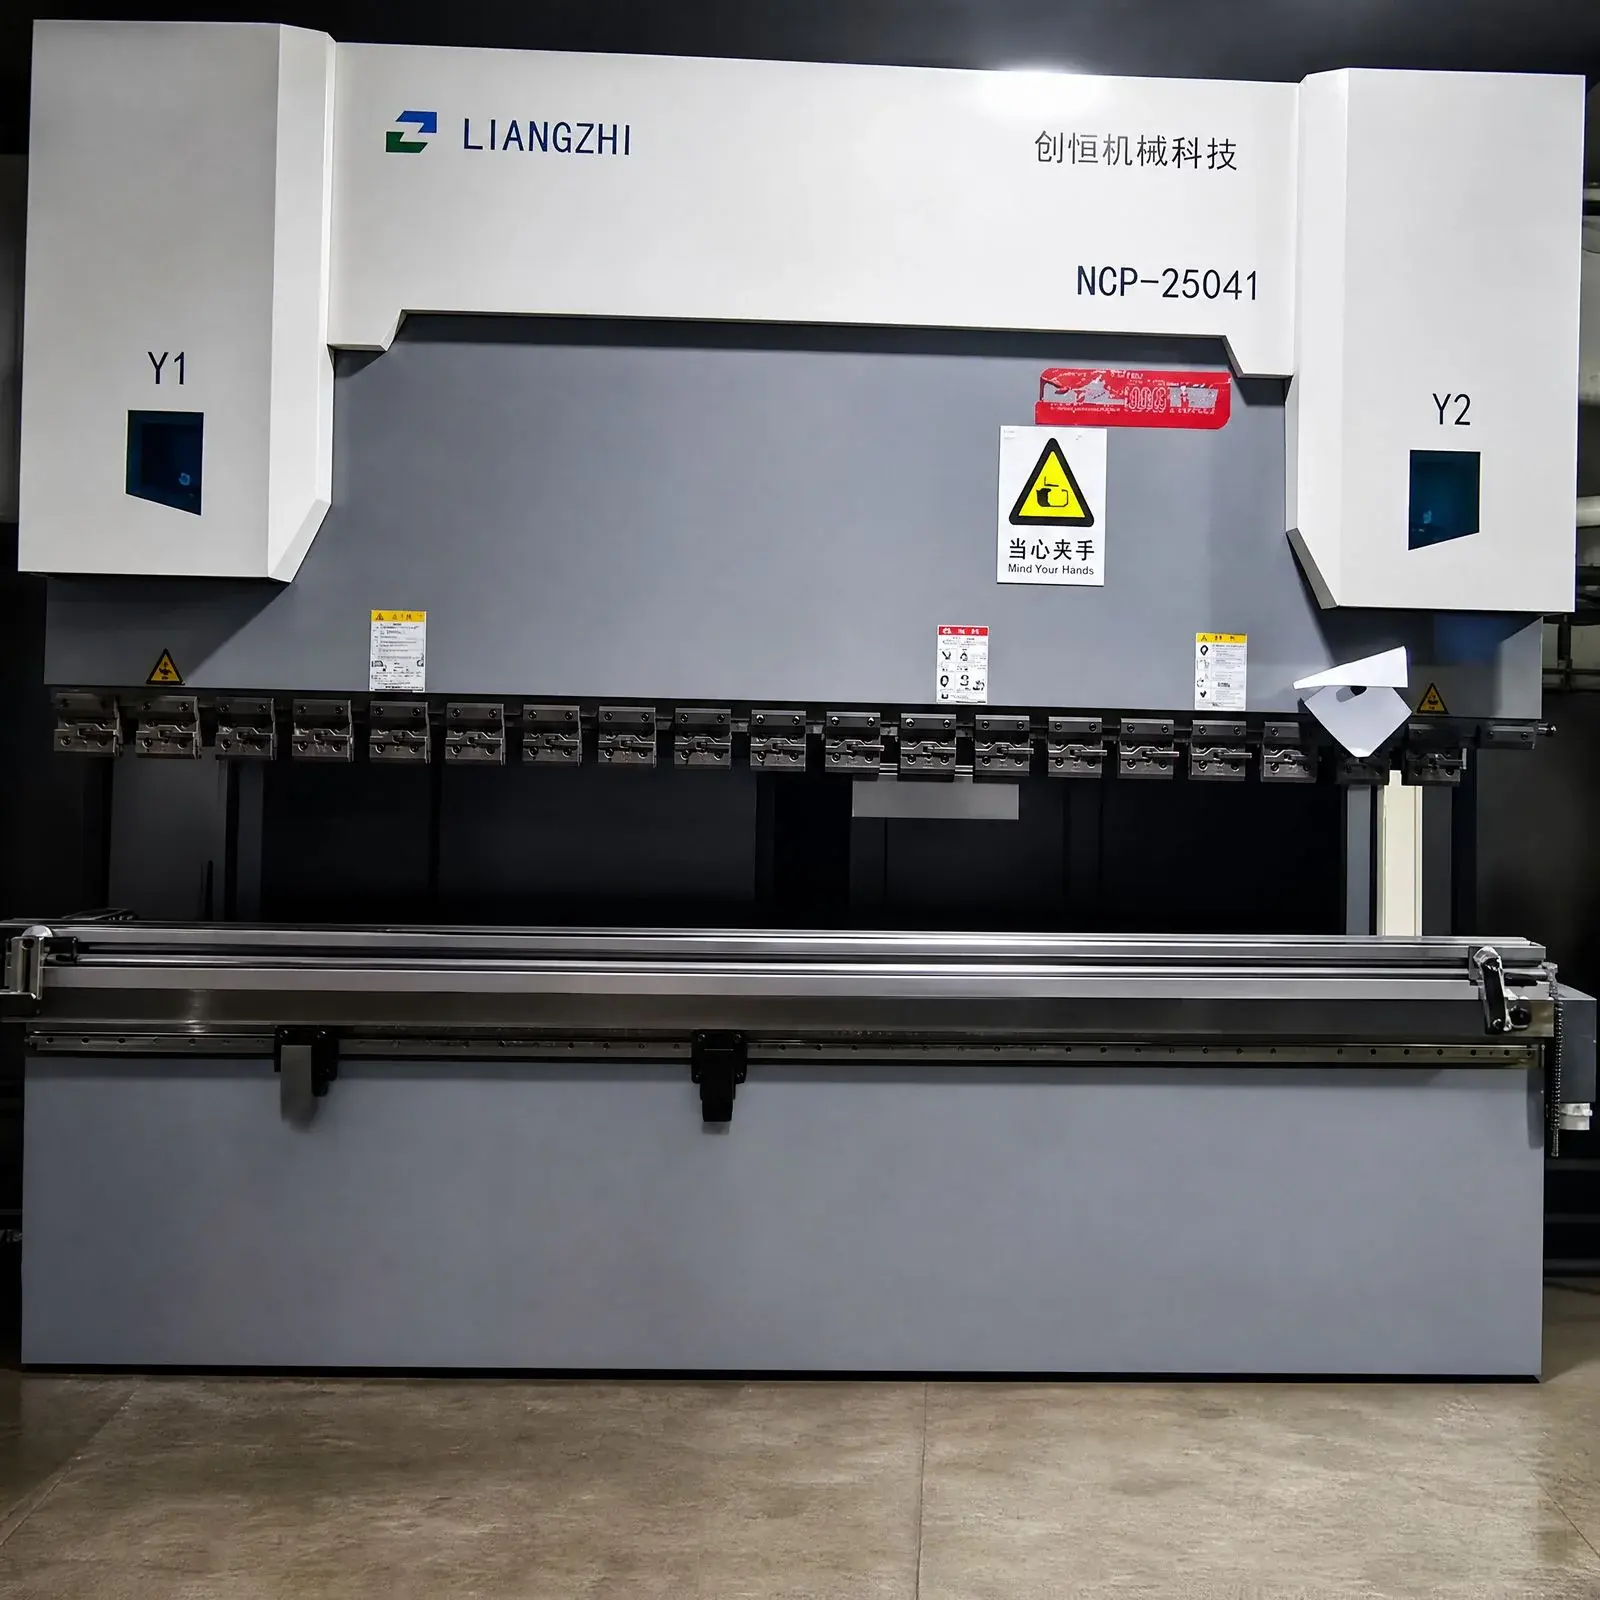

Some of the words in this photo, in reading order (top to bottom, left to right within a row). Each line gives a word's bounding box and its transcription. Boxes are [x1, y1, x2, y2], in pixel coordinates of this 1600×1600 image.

[463, 117, 630, 155] LIANGZHI
[1034, 130, 1238, 171] 创恒机械科技
[1077, 264, 1257, 300] NCP-25041
[147, 351, 185, 385] Y1
[1432, 393, 1471, 425] Y2
[1008, 537, 1095, 561] 当心夹手
[1007, 563, 1033, 574] Mind
[1035, 564, 1059, 575] Your
[1061, 565, 1095, 576] Hands
